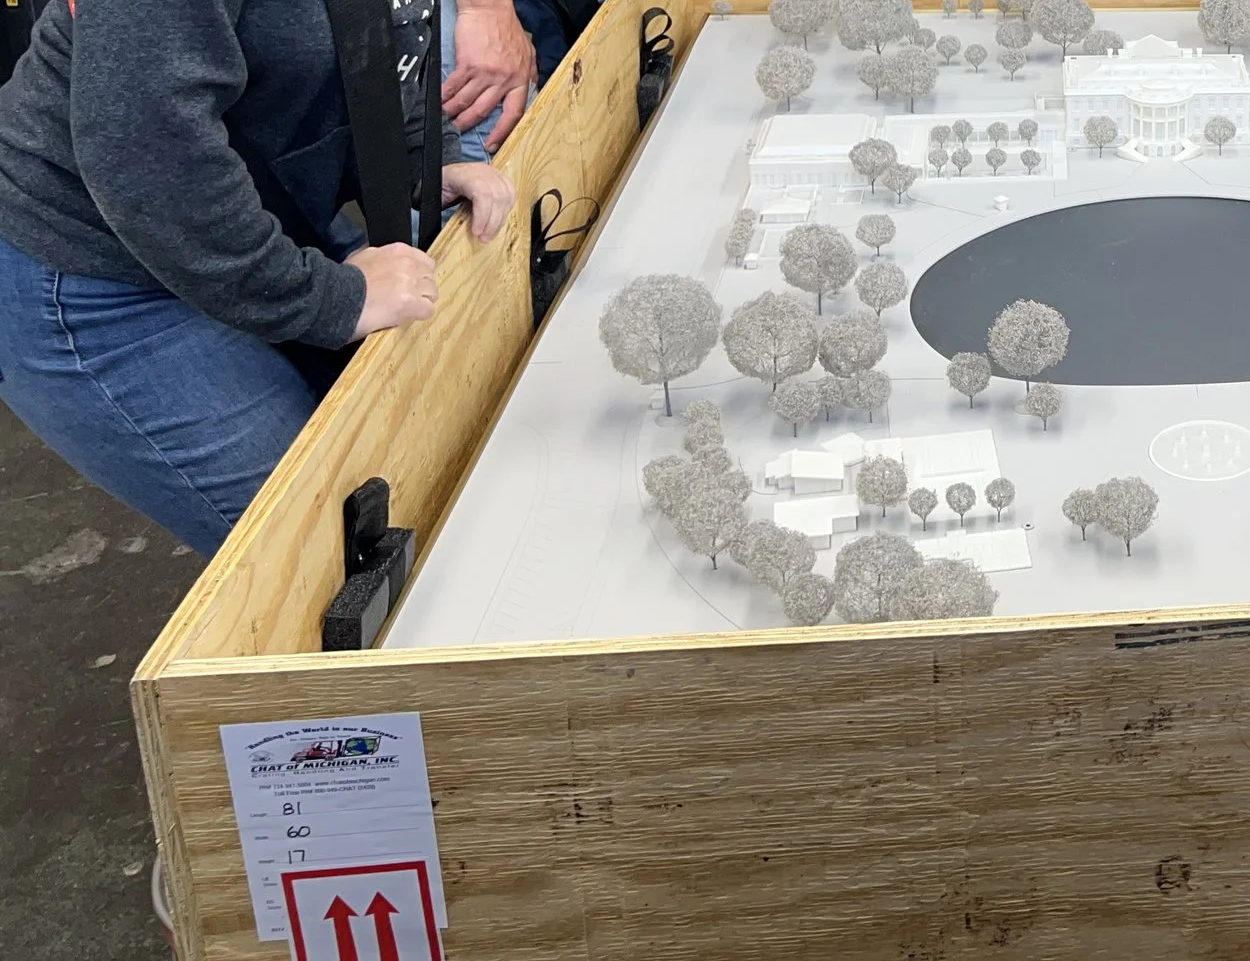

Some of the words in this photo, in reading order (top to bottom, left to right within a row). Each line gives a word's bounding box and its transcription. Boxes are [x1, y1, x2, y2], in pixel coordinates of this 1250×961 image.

[302, 726, 329, 734] World
[250, 765, 282, 773] CHAT
[303, 758, 371, 769] MICHIGAN,
[282, 801, 302, 816] 81
[286, 825, 311, 839] 60
[287, 849, 305, 864] 17
